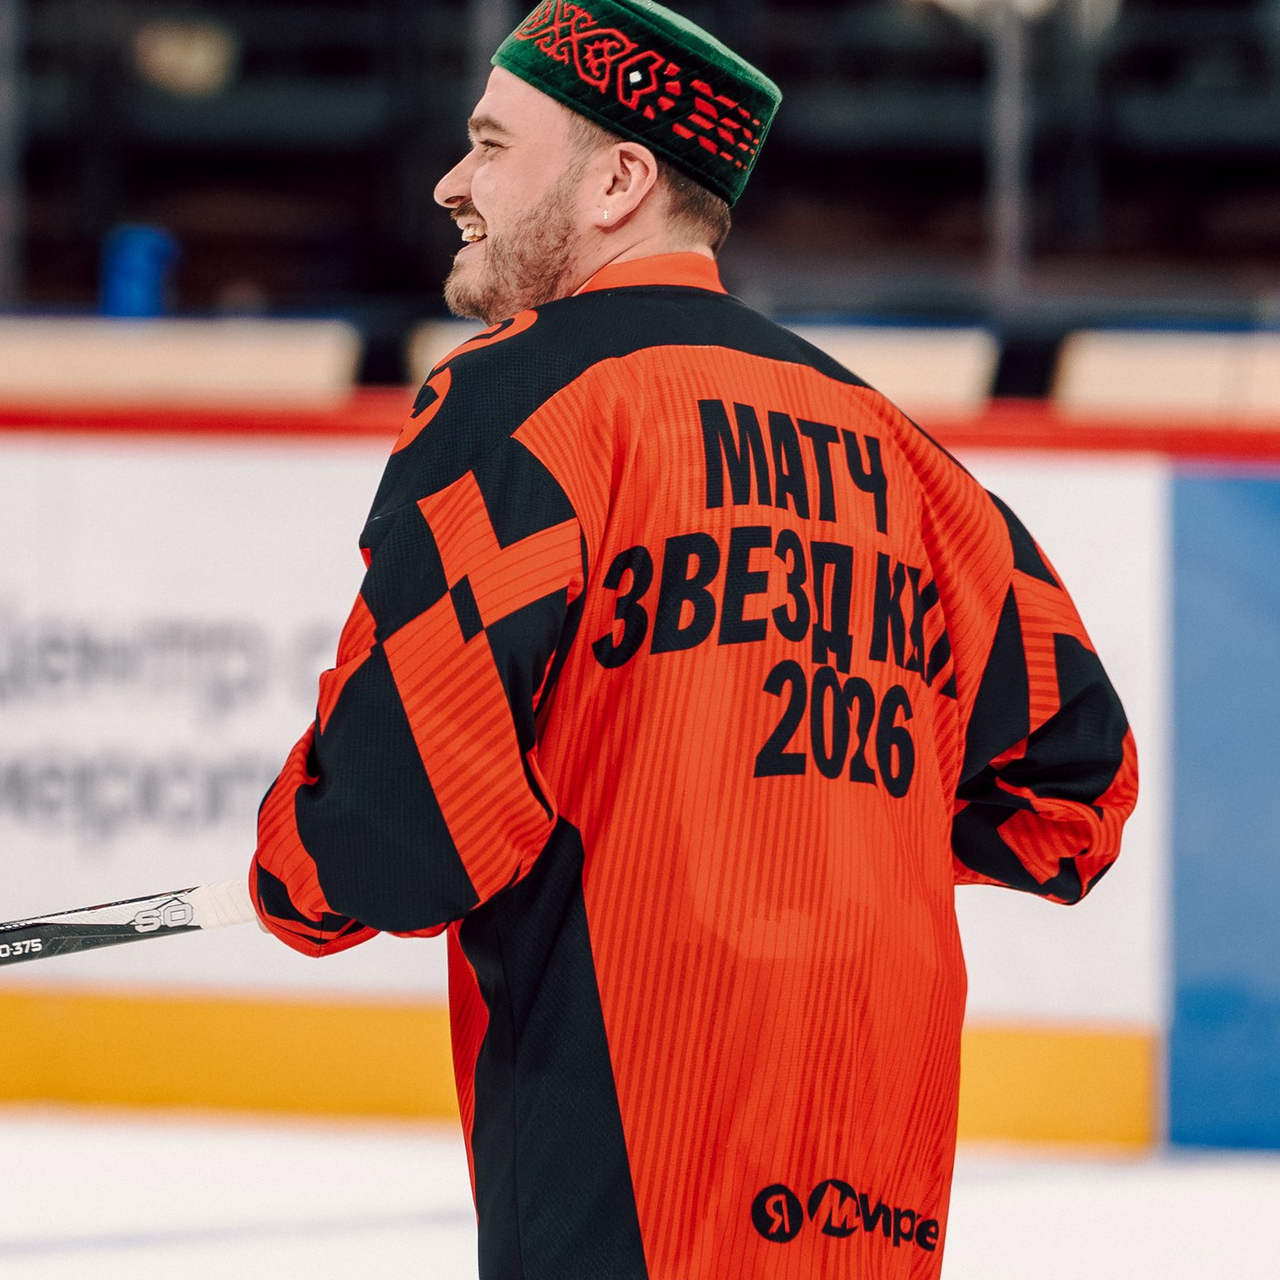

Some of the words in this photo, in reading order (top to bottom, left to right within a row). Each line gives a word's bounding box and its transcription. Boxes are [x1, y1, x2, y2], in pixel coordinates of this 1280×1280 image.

[697, 398, 888, 536] МАТЧ
[591, 525, 854, 675] ЗВЕЗД
[753, 659, 916, 799] 2026
